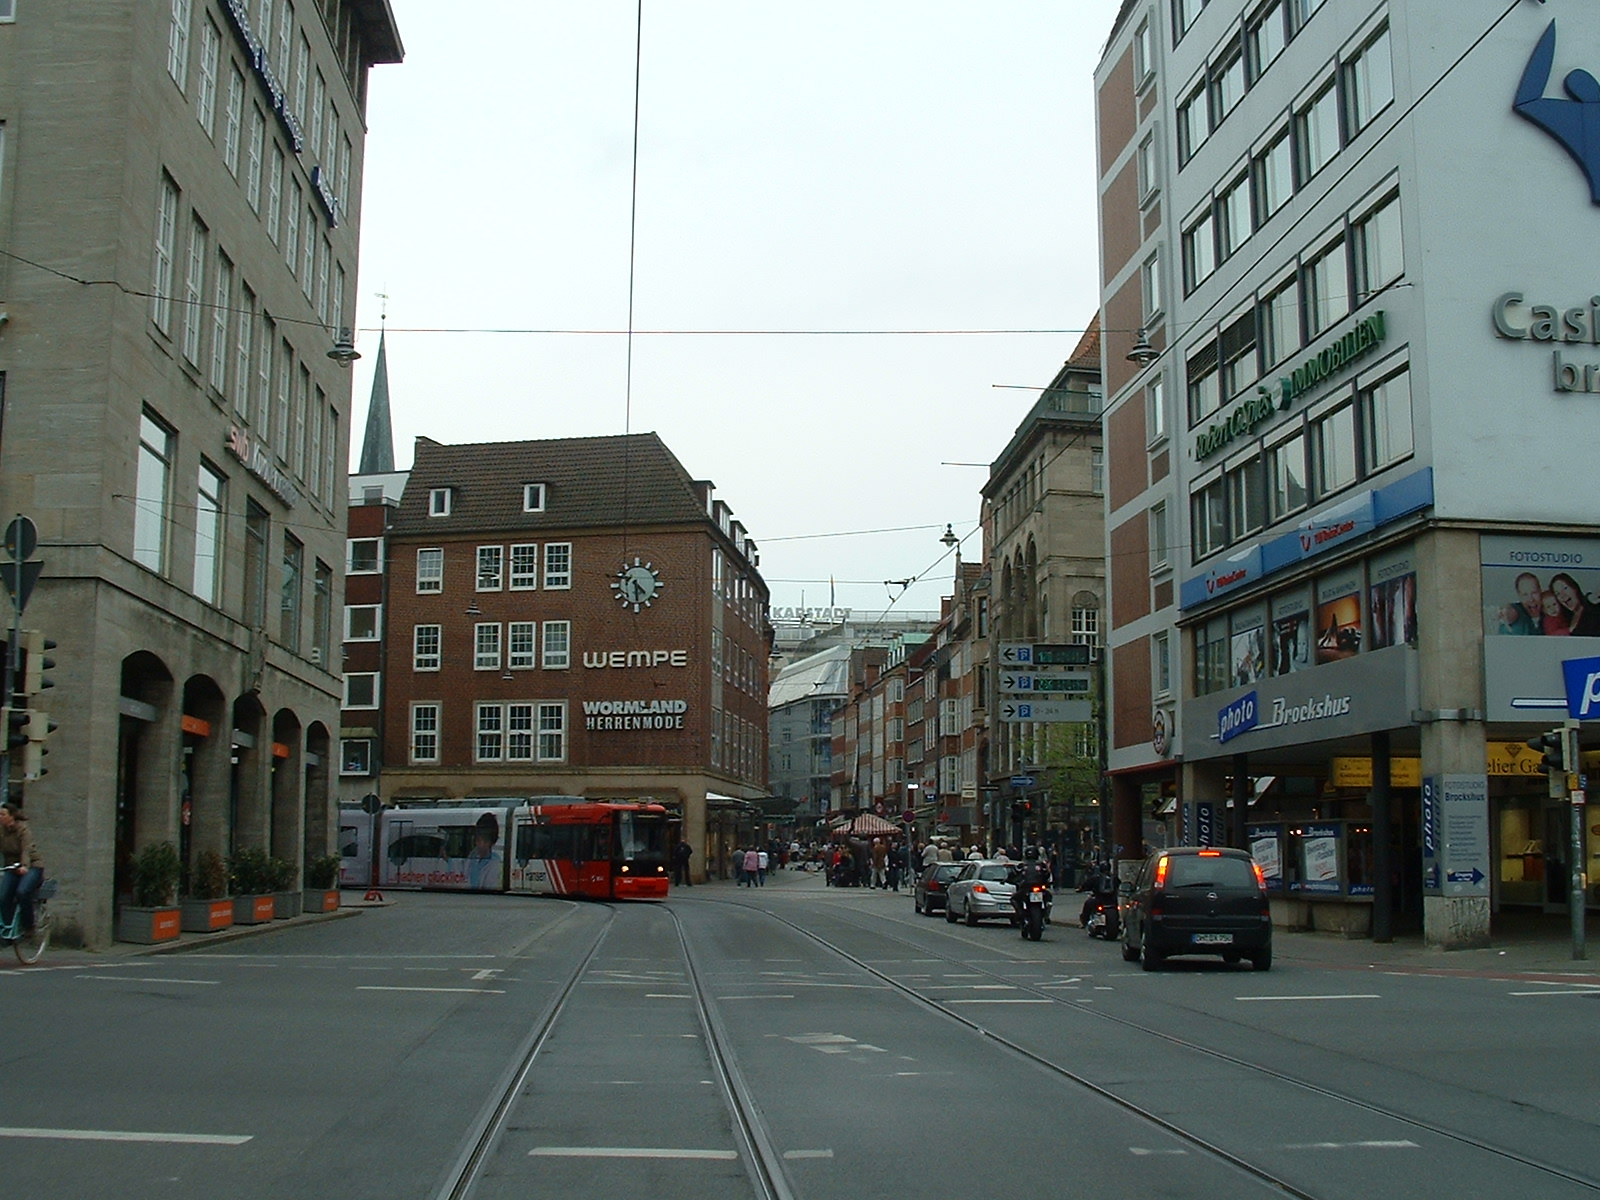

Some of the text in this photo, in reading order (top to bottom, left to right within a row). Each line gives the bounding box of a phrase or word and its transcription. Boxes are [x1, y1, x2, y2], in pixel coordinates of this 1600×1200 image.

[1291, 311, 1386, 398] IMMOBILIEN
[1510, 551, 1582, 563] FOTOSTUDIO
[773, 607, 852, 619] KARSTADT
[583, 650, 687, 668] WEMPE
[583, 699, 687, 715] WORMLAND
[587, 715, 684, 730] HERRENMODE
[1220, 695, 1351, 740] photo Brockshus
[1445, 792, 1486, 801] Brockshus
[1424, 784, 1434, 851] photo
